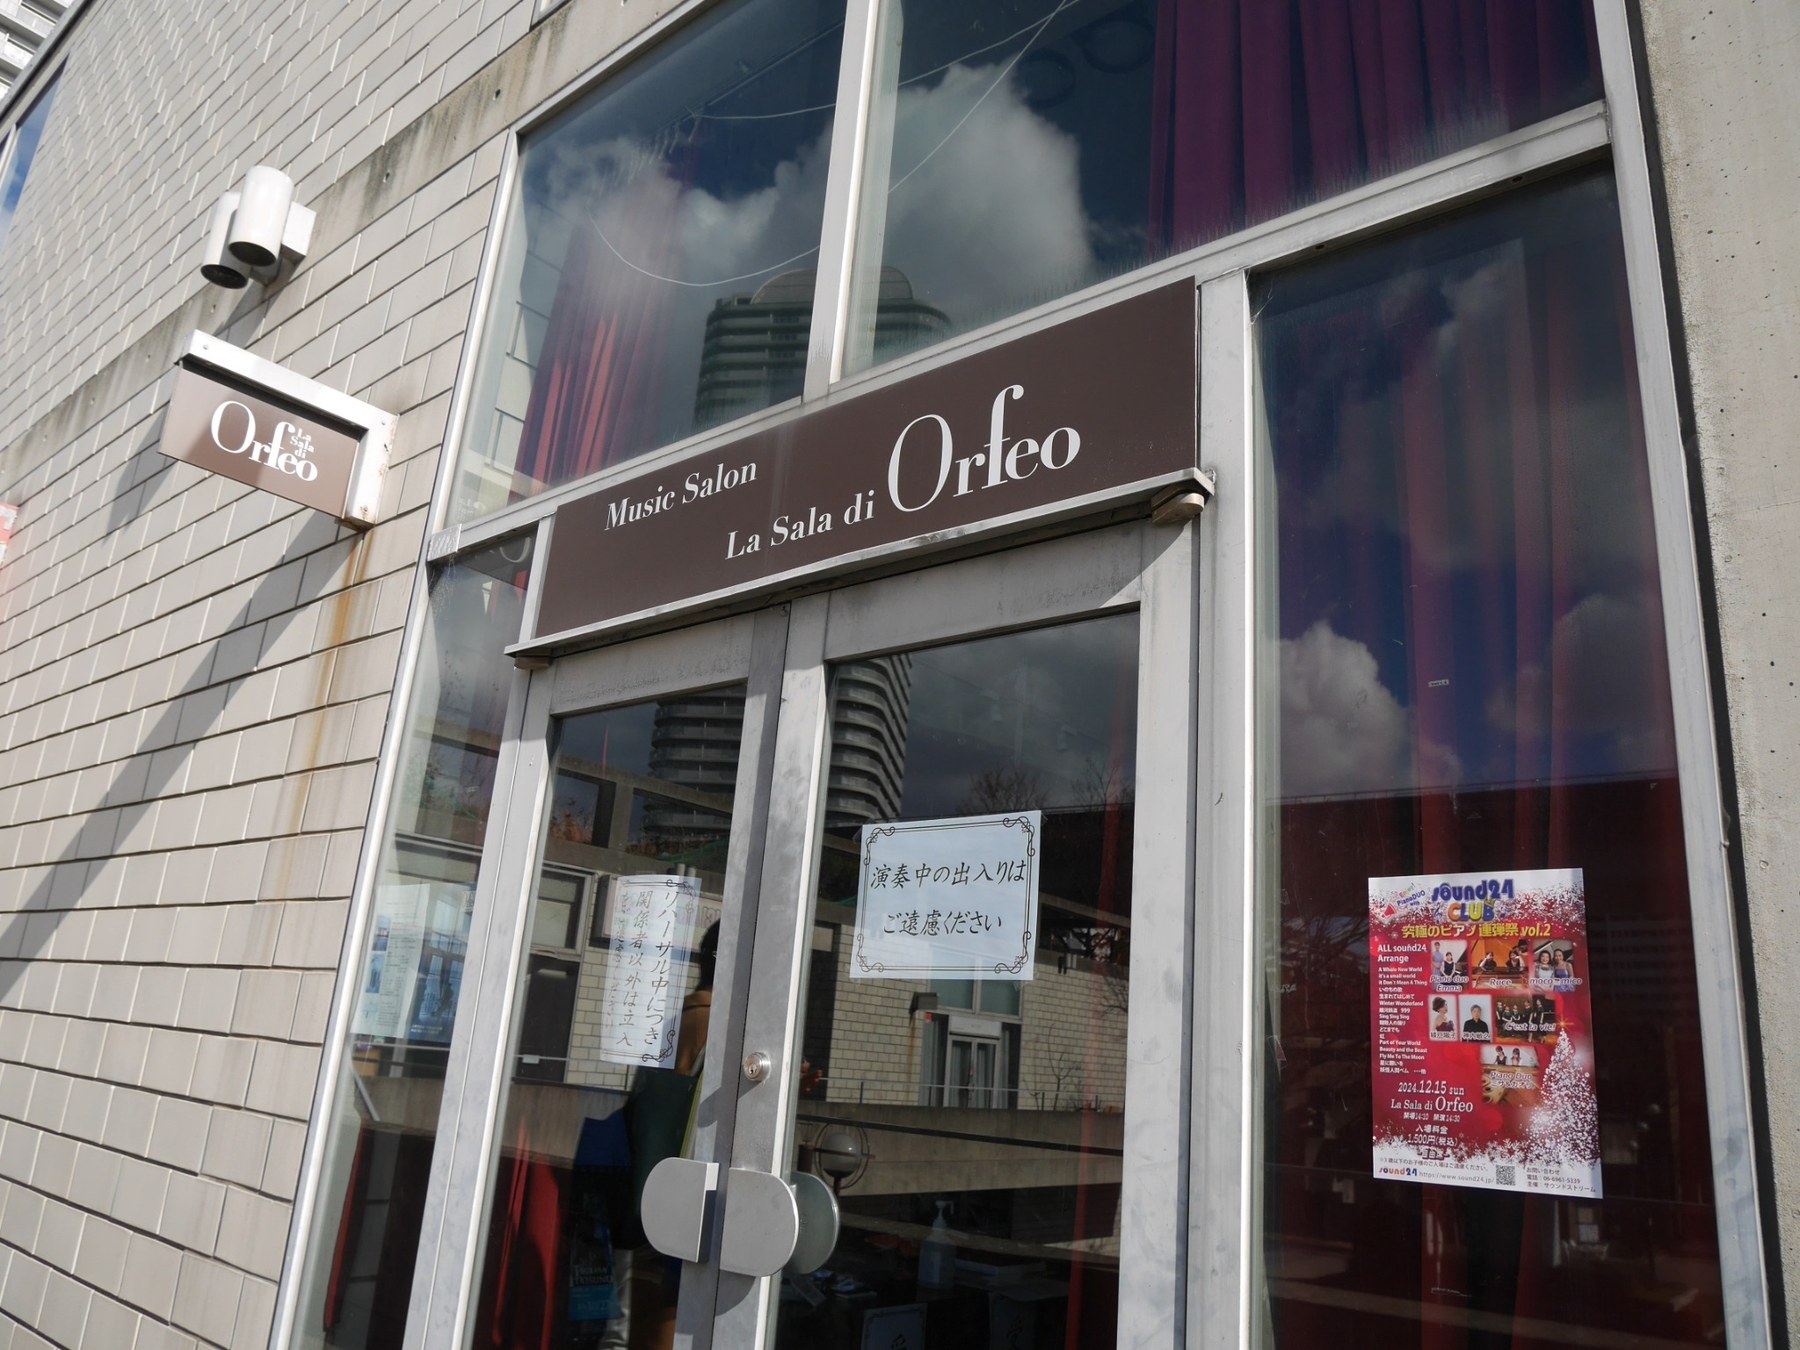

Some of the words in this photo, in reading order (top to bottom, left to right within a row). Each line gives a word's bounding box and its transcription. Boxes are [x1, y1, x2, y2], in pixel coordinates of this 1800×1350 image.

[211, 401, 318, 481] Orfeo
[297, 428, 311, 442] La
[290, 435, 314, 453] Sala
[294, 448, 307, 459] di
[725, 530, 761, 560] La
[770, 506, 833, 547] Sala
[843, 489, 875, 525] di
[887, 384, 1081, 512] Orfeo
[604, 485, 676, 531] Music
[682, 462, 757, 505] Salon
[870, 860, 1027, 889] 演奏中の出入りは
[1431, 879, 1514, 902] sound24
[1447, 902, 1495, 922] CLUB
[883, 909, 1002, 937] ご遠慮ください
[1521, 923, 1551, 937] vol.2
[1378, 944, 1392, 953] ALL
[1393, 944, 1428, 953] sound24
[1378, 954, 1409, 964] Arrange
[616, 890, 653, 1047] 関係者以外は立入
[644, 891, 680, 1045] リハーサル中につき
[1398, 1080, 1447, 1094] 2024.12.15
[1449, 1087, 1464, 1096] sun
[1391, 1099, 1402, 1109] La
[1404, 1100, 1422, 1110] Sala
[1424, 1101, 1433, 1110] di
[1435, 1096, 1474, 1112] Orfeo
[1416, 1124, 1448, 1134] 入場料金
[1379, 1168, 1418, 1176] sound24
[1526, 1167, 1560, 1176] お問い合わせ
